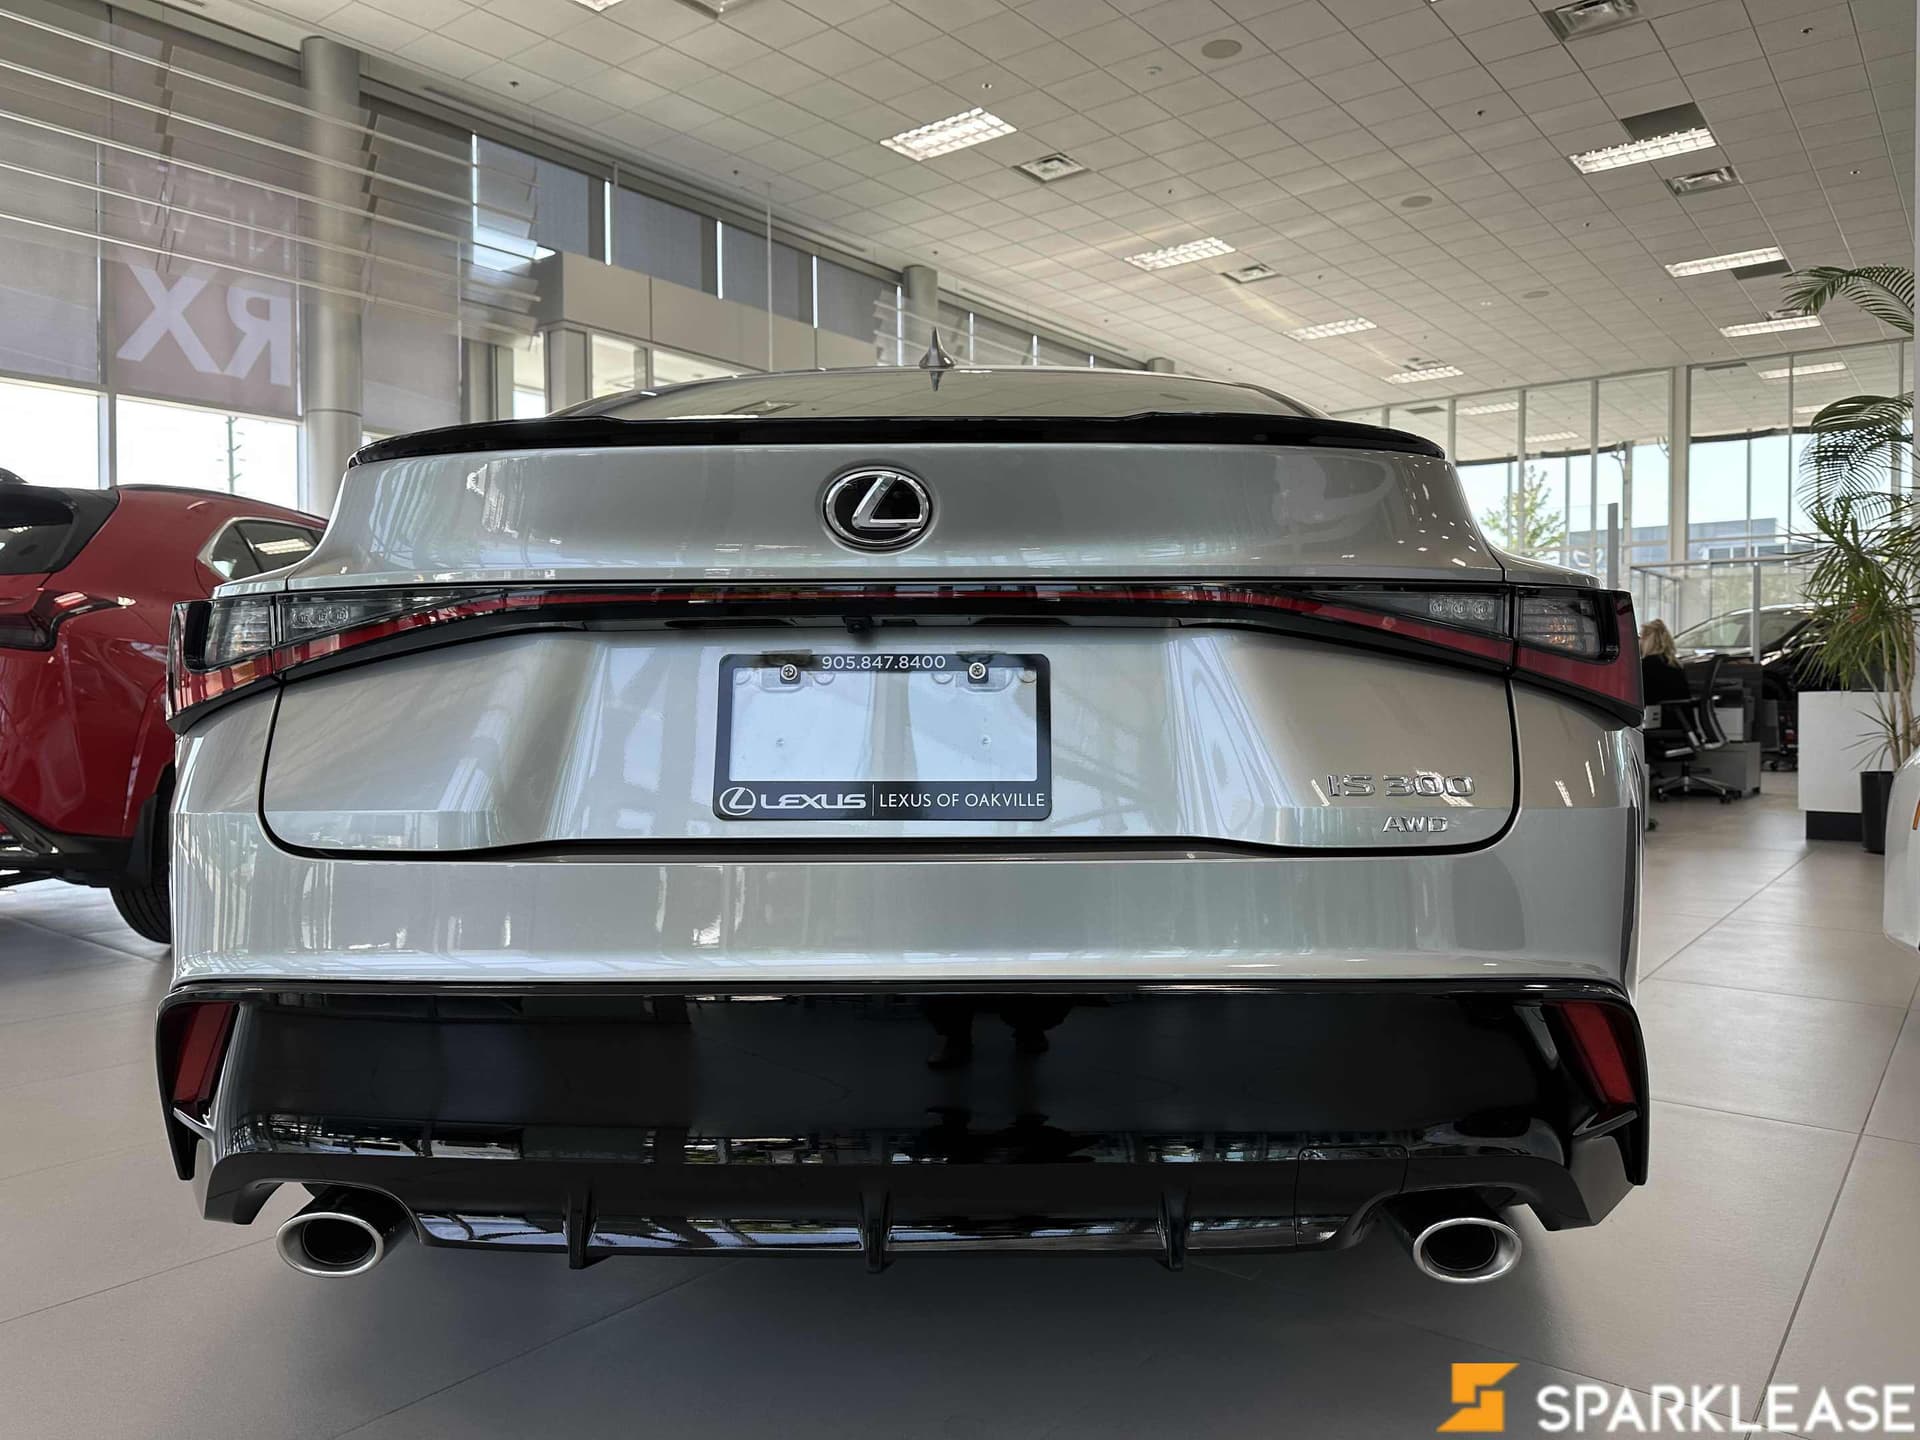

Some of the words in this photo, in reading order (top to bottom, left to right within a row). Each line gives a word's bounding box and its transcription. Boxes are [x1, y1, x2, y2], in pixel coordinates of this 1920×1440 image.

[821, 655, 946, 670] 905.847.8400
[1327, 775, 1376, 797] IS
[1383, 775, 1476, 797] 300
[760, 793, 867, 809] LEXUS
[879, 793, 933, 808] LEXUS
[936, 793, 959, 808] OF
[964, 792, 1045, 807] OAKVILLE
[1382, 815, 1449, 833] AWD
